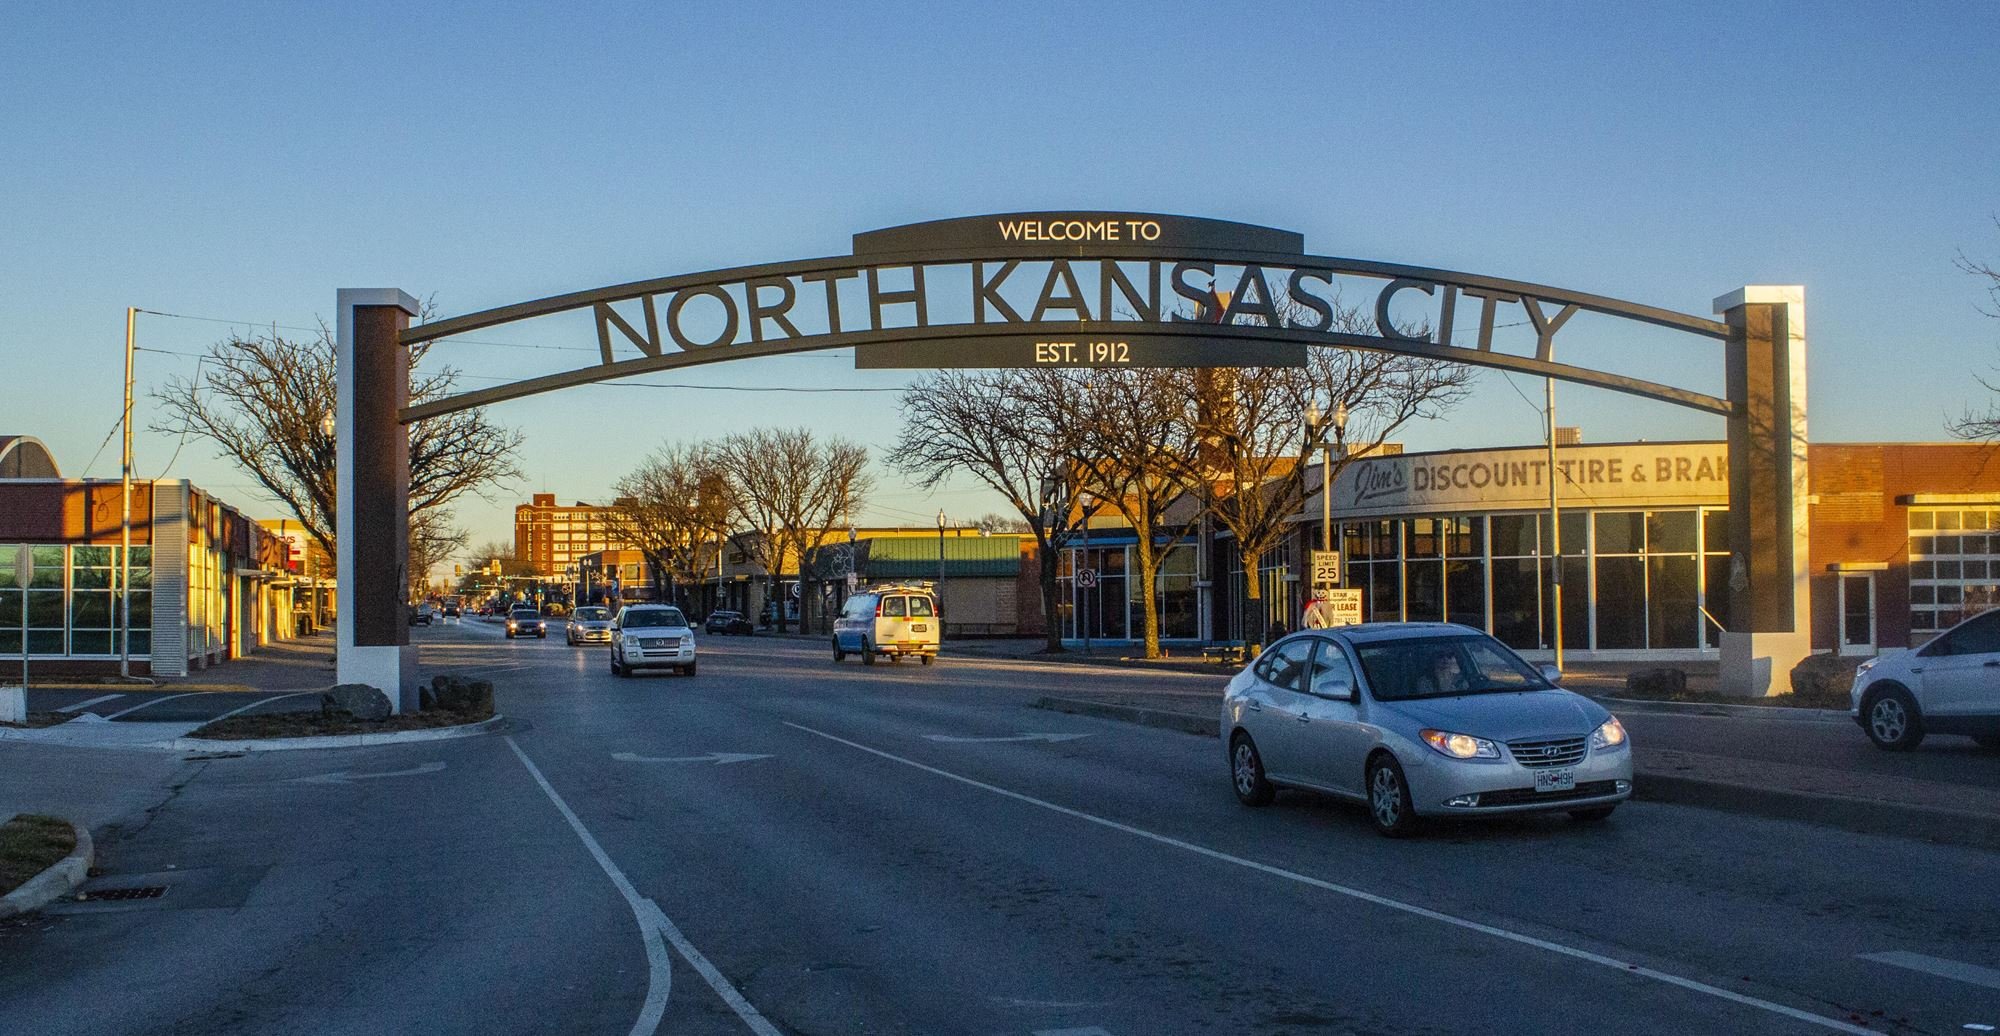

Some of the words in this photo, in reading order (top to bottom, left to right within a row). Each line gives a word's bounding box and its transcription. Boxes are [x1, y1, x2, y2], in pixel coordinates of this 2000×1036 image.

[999, 221, 1119, 241] WELCOME
[1126, 221, 1161, 241] TO
[593, 264, 928, 365] NORTH
[972, 257, 1333, 332] KANSAS
[1376, 277, 1581, 361] CITY
[1035, 342, 1078, 363] EST.
[1089, 342, 1130, 363] 1912
[1354, 461, 1406, 505] Jim's
[1414, 460, 1546, 492] DISCOUNT
[1558, 458, 1623, 484] TIRE
[1631, 463, 1647, 482] &
[1317, 567, 1336, 579] 25
[1337, 603, 1357, 611] LEASE
